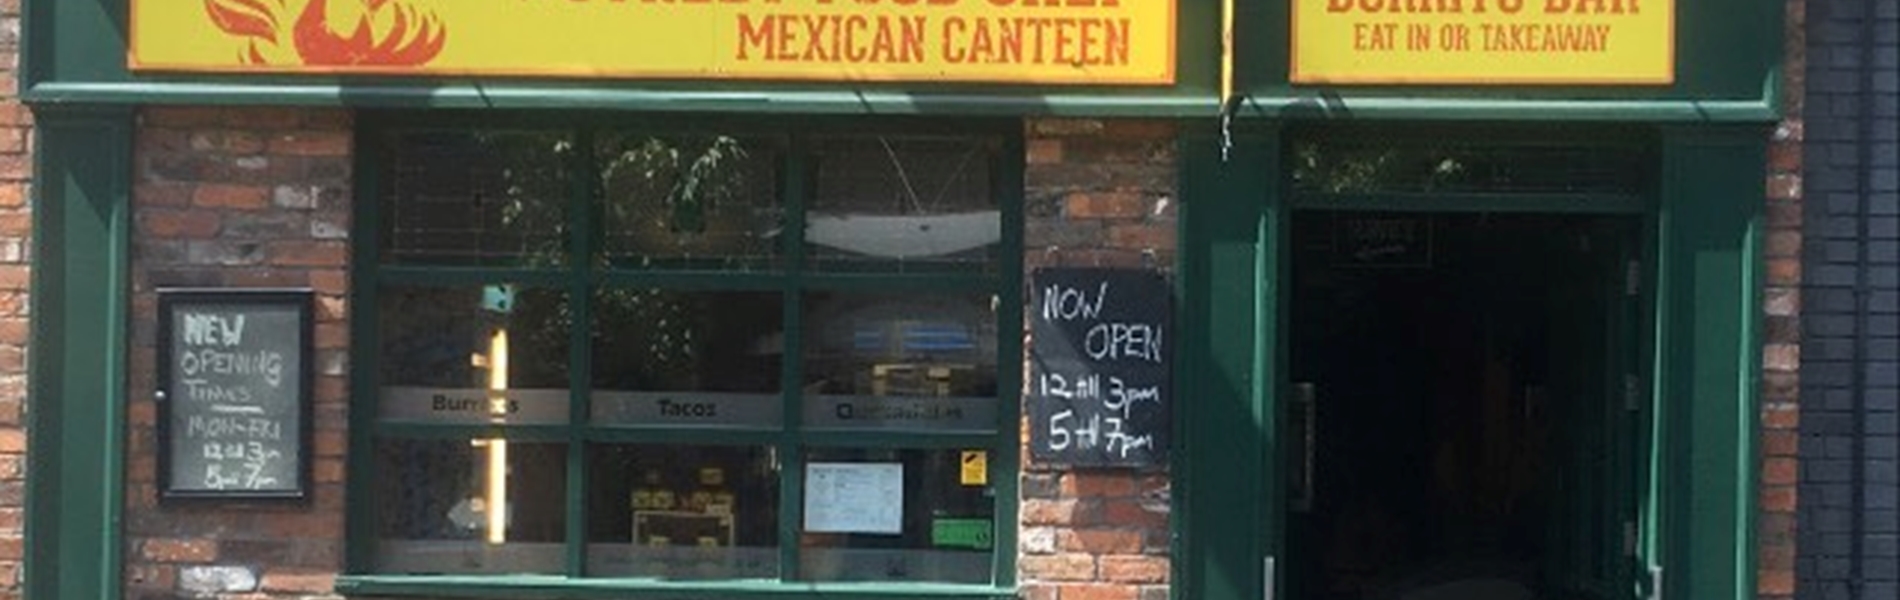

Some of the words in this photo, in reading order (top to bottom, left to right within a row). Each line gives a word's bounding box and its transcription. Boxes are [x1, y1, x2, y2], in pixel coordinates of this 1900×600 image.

[736, 14, 926, 63] MEXICAN
[942, 16, 1131, 65] CANTEEN
[1353, 23, 1398, 50] EAT
[1407, 23, 1431, 50] IN
[1439, 23, 1470, 51] OR
[1478, 23, 1611, 51] TAKEAWAY
[1043, 282, 1107, 320] NOW
[184, 314, 245, 346] NEW
[1085, 323, 1161, 363] OPEN
[180, 348, 283, 387] OPENING
[432, 394, 519, 413] Burrs
[656, 399, 717, 417] Tacos
[1041, 373, 1072, 398] 12
[1103, 376, 1161, 419] 3pm
[203, 442, 223, 460] 12
[1048, 409, 1073, 450] 5
[1104, 418, 1154, 458] 7pm
